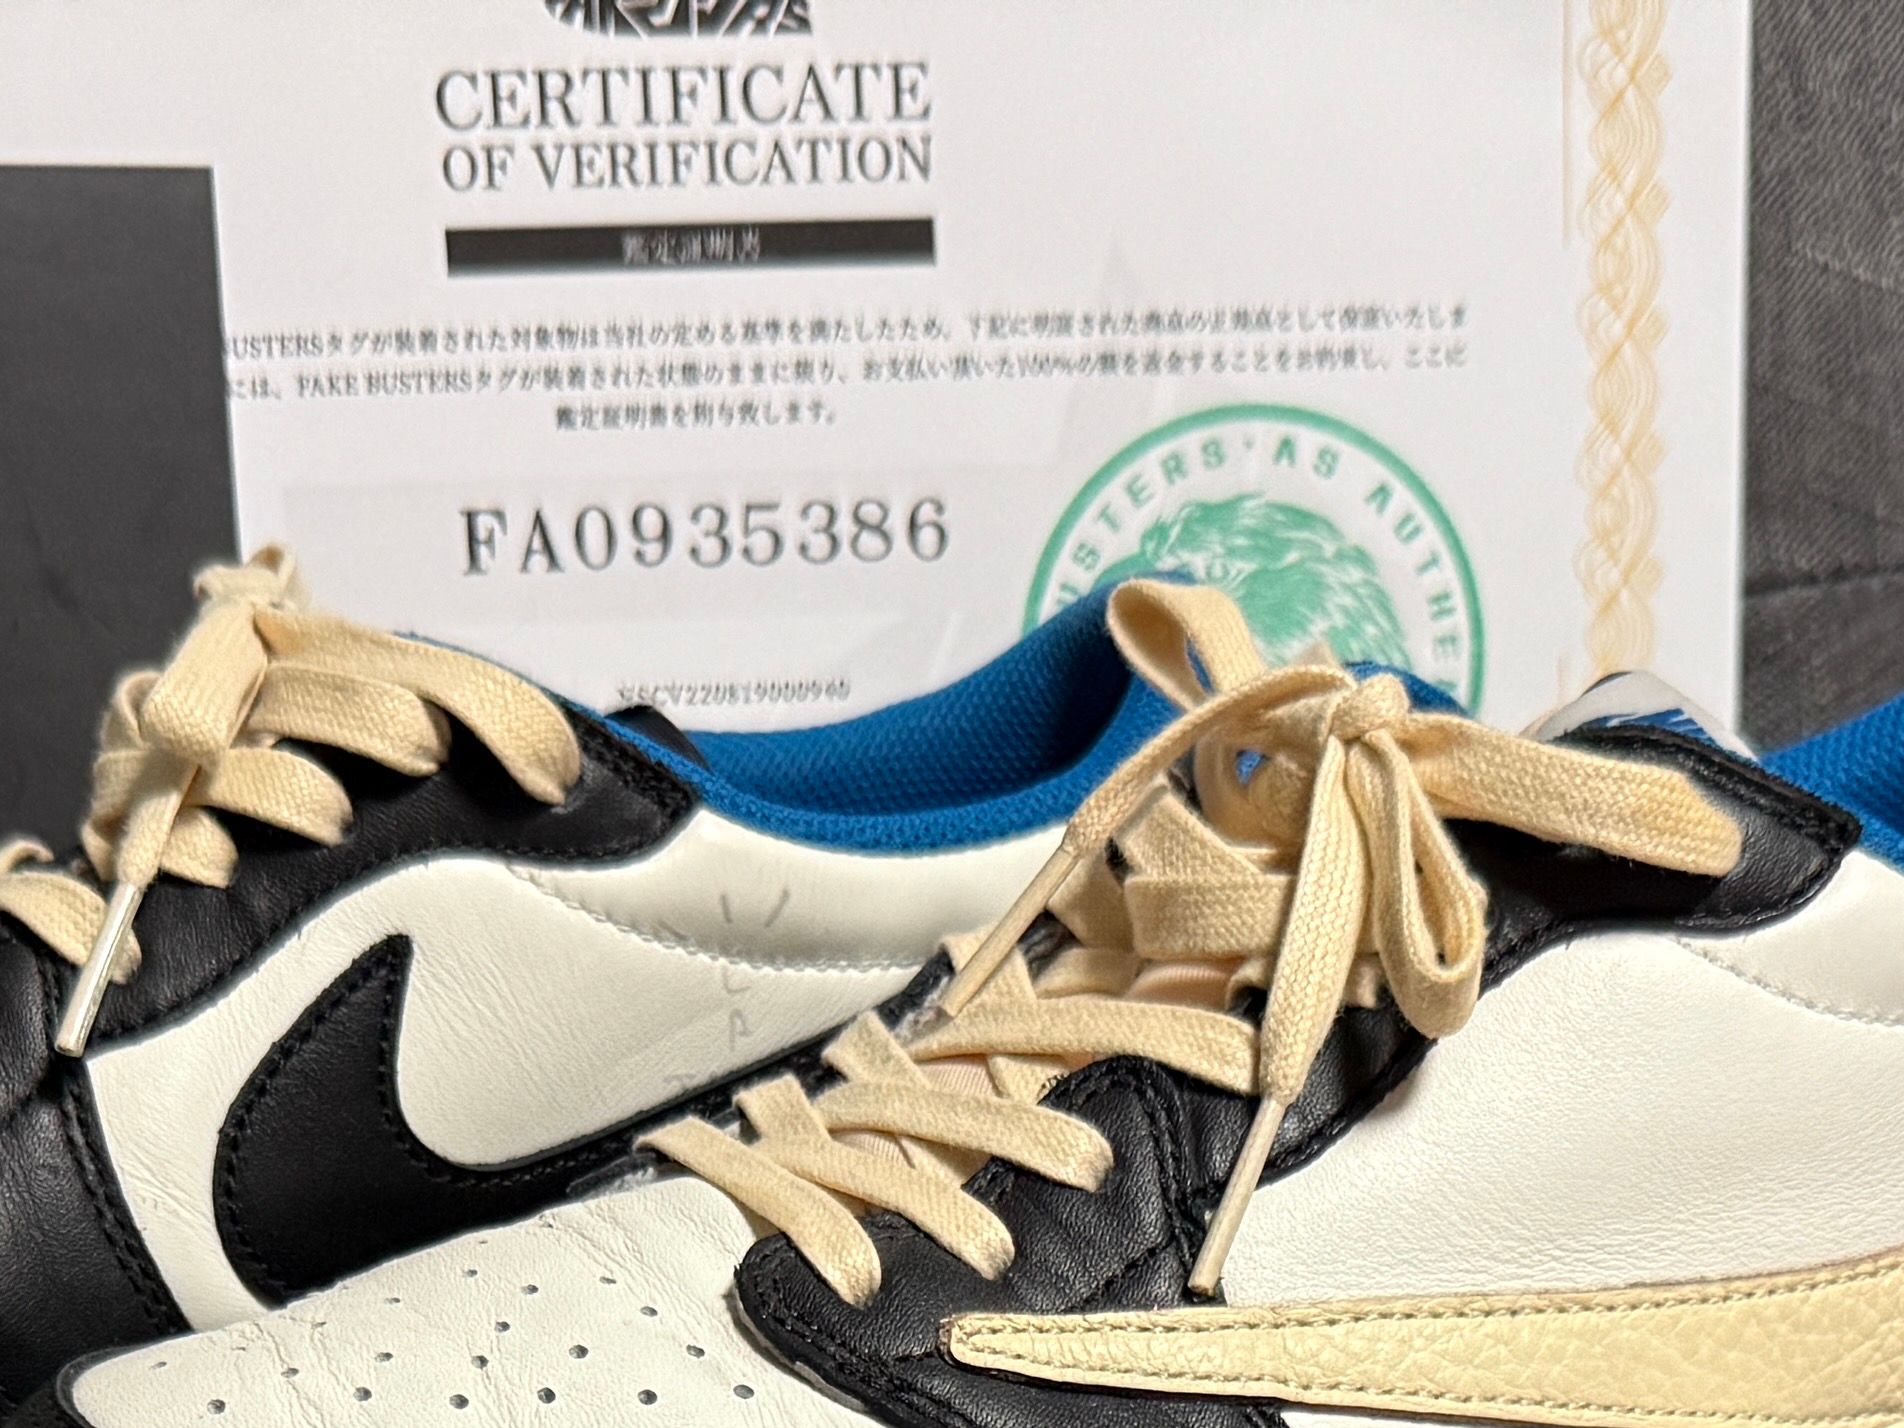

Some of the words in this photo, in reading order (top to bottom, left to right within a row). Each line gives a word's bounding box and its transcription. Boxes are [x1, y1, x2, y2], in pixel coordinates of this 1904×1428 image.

[435, 60, 934, 132] CERTIFICATE
[442, 143, 511, 192] OF
[531, 134, 934, 191] VERIFICATION
[1272, 435, 1343, 481] AS
[459, 497, 951, 577] FA0935386
